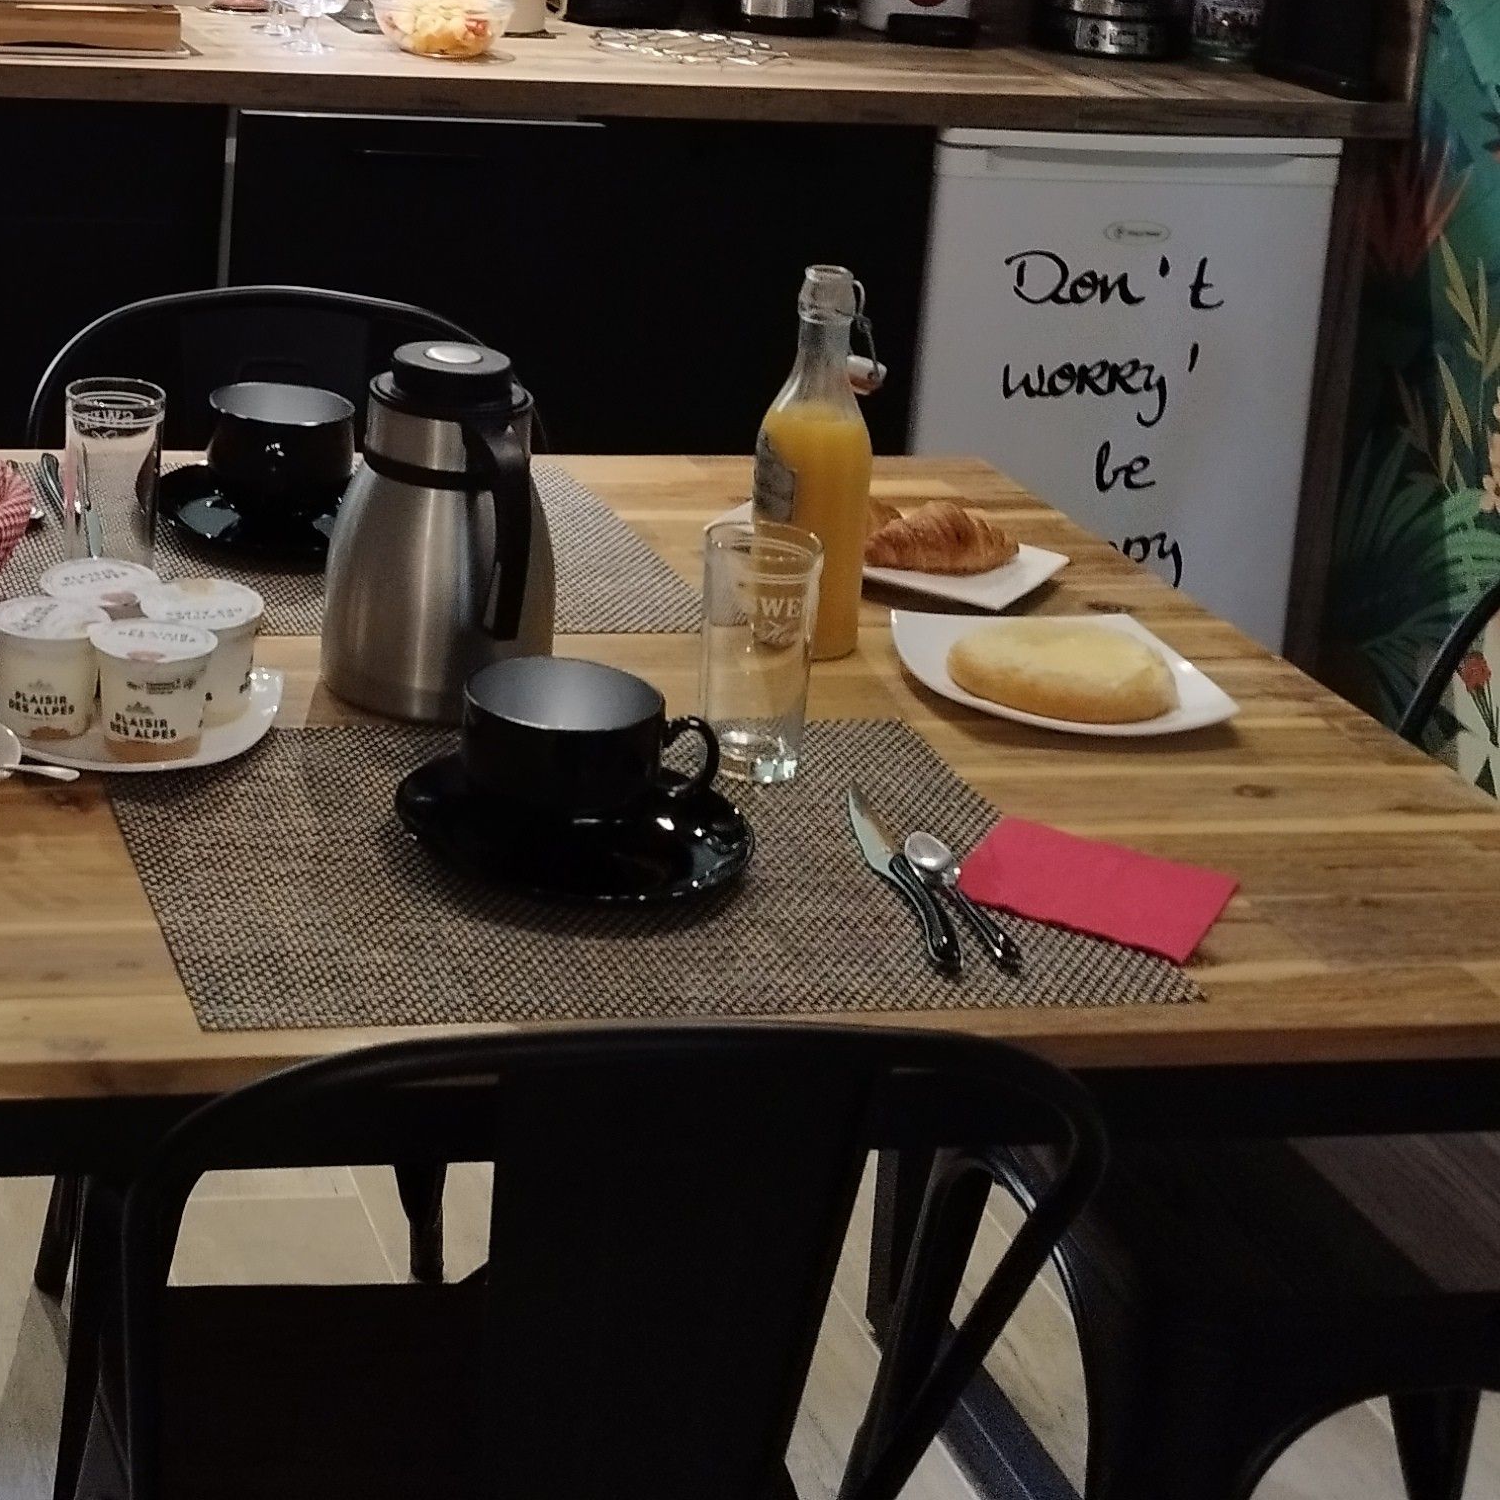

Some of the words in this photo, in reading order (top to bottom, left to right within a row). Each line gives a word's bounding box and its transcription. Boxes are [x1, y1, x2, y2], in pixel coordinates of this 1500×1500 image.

[1005, 250, 1224, 310] Don't
[1095, 440, 1156, 492] be
[15, 691, 67, 705] PLAISIR
[8, 701, 29, 713] DES
[33, 704, 75, 716] ALPES
[115, 712, 168, 728] PLAISIR
[109, 721, 130, 737] DES
[134, 728, 177, 739] ALPES
